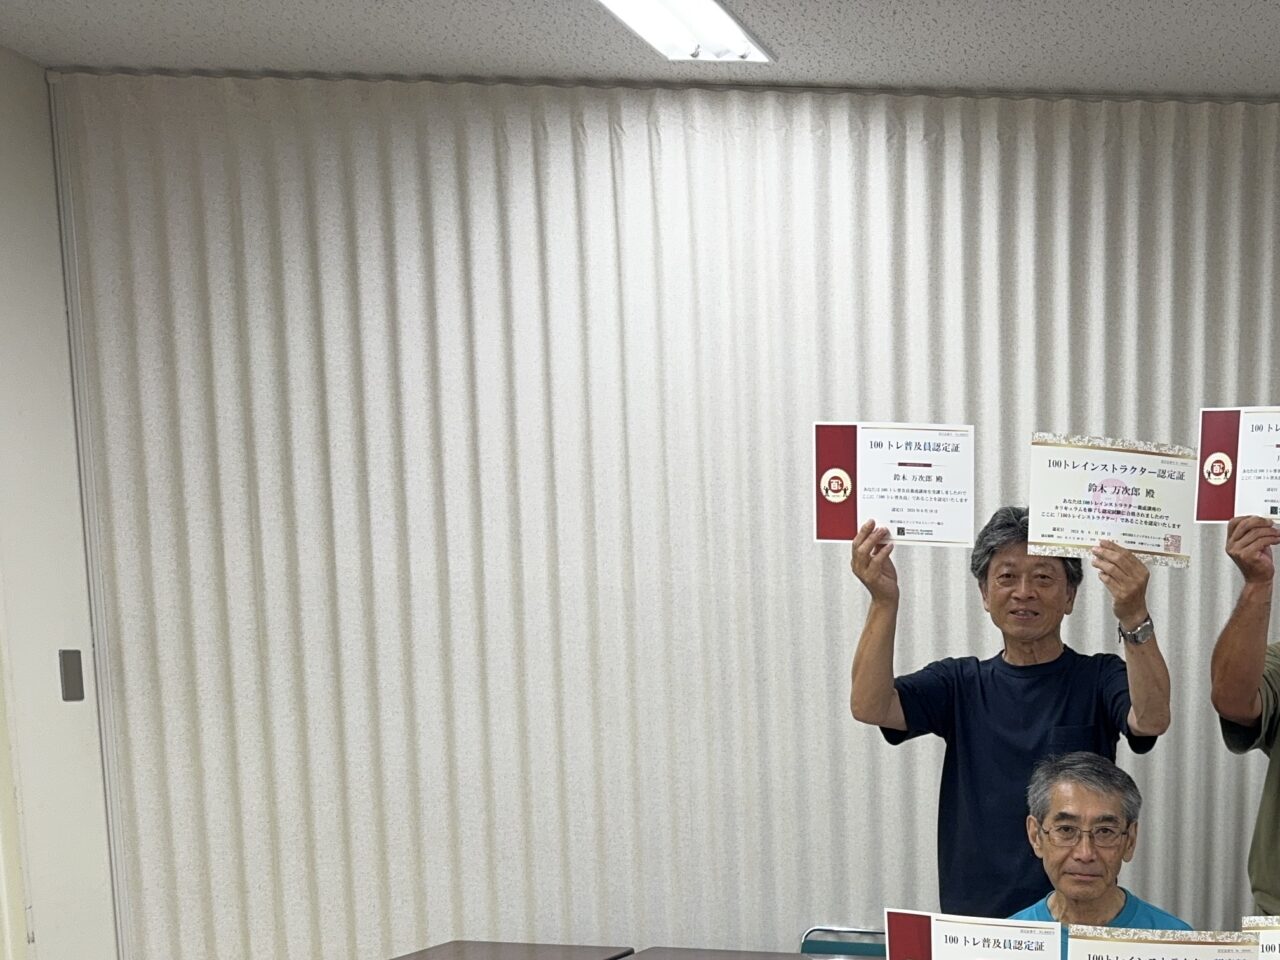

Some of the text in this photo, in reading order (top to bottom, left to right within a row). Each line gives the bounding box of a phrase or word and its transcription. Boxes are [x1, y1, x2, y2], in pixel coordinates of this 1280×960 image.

[1048, 459, 1186, 481] 100トレインストラクター認定証
[1111, 485, 1141, 497] 万次郎
[1145, 488, 1155, 499] 殿
